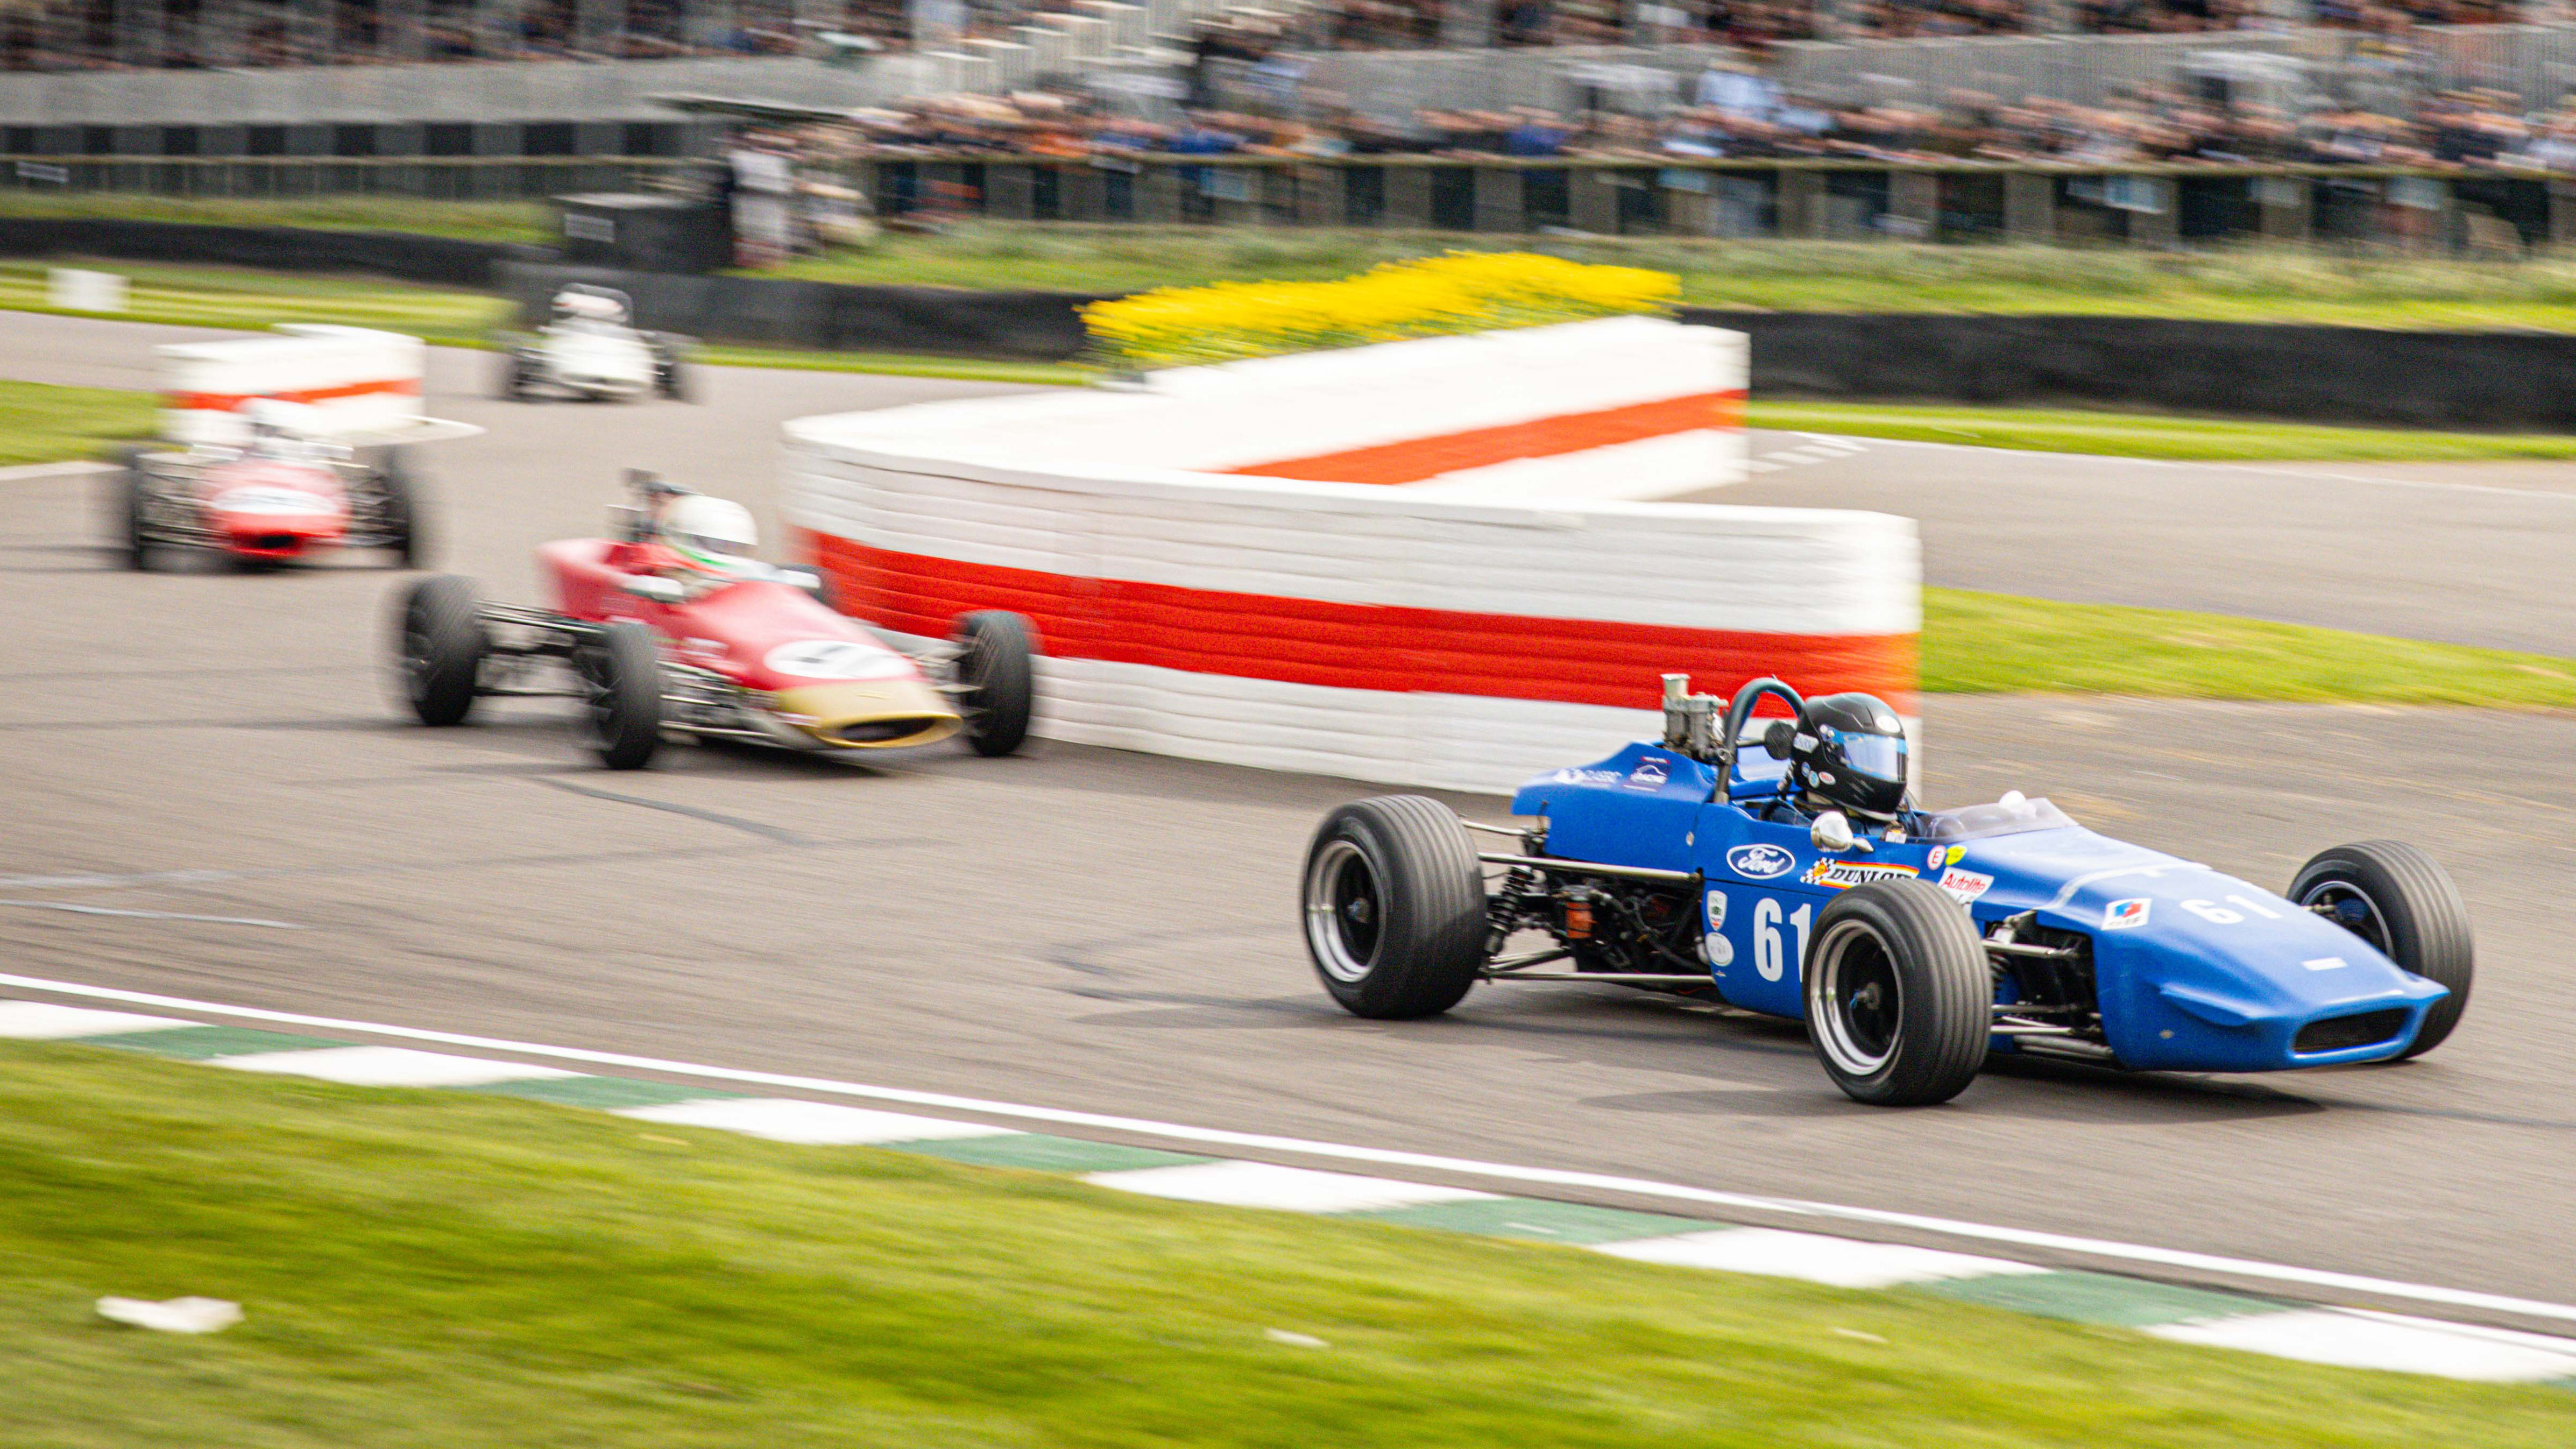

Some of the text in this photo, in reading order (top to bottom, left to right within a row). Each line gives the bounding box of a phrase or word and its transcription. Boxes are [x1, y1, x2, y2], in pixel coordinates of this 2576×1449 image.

[1737, 847, 1785, 874] Ford
[1931, 851, 1941, 864] E
[1941, 872, 1986, 894] Autolite
[2179, 894, 2283, 925] 61
[1753, 897, 1811, 983] 61
